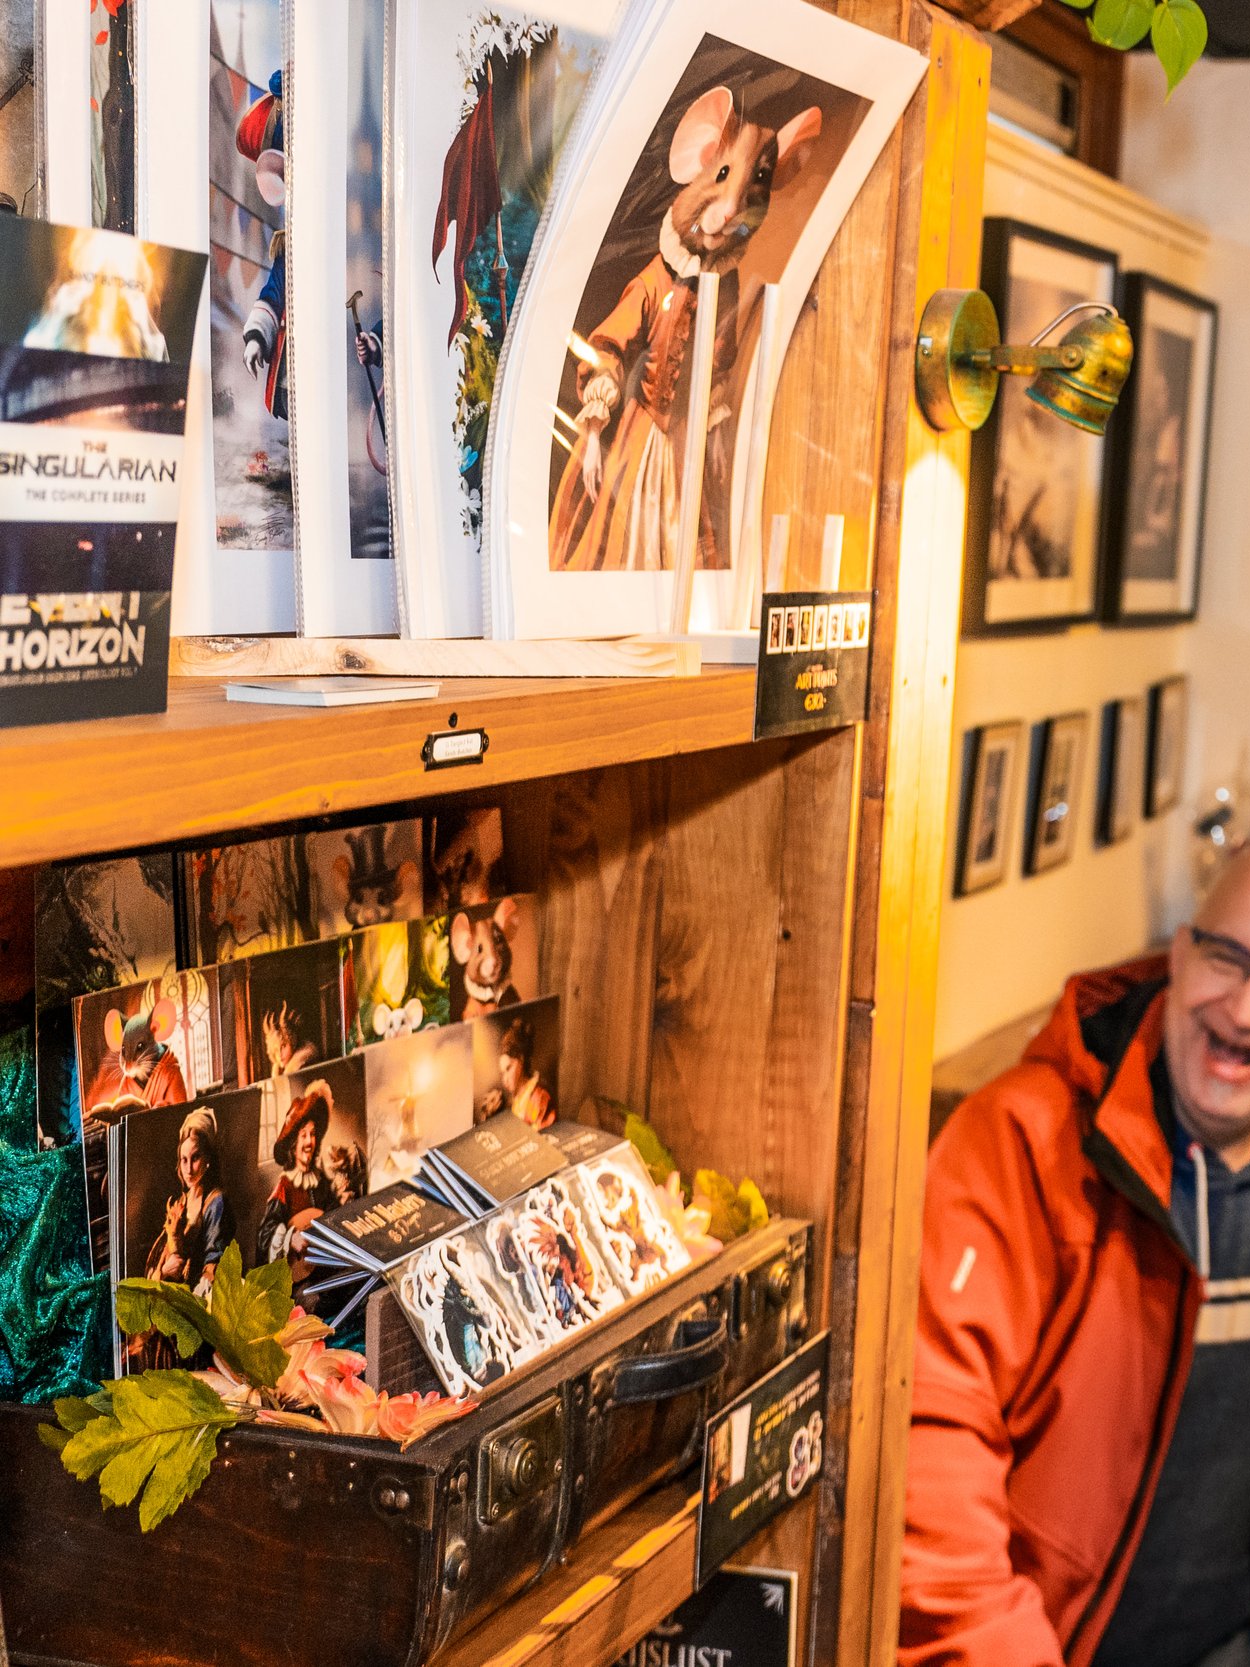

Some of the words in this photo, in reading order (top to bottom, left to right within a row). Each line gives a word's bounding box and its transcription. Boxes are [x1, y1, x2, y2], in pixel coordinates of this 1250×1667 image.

[83, 440, 108, 454] THE
[0, 452, 177, 482] SINGULARIAN
[26, 488, 46, 501] THE
[51, 489, 108, 503] COMPLETE
[112, 491, 146, 504] SERIES
[0, 621, 146, 671] HORIZON
